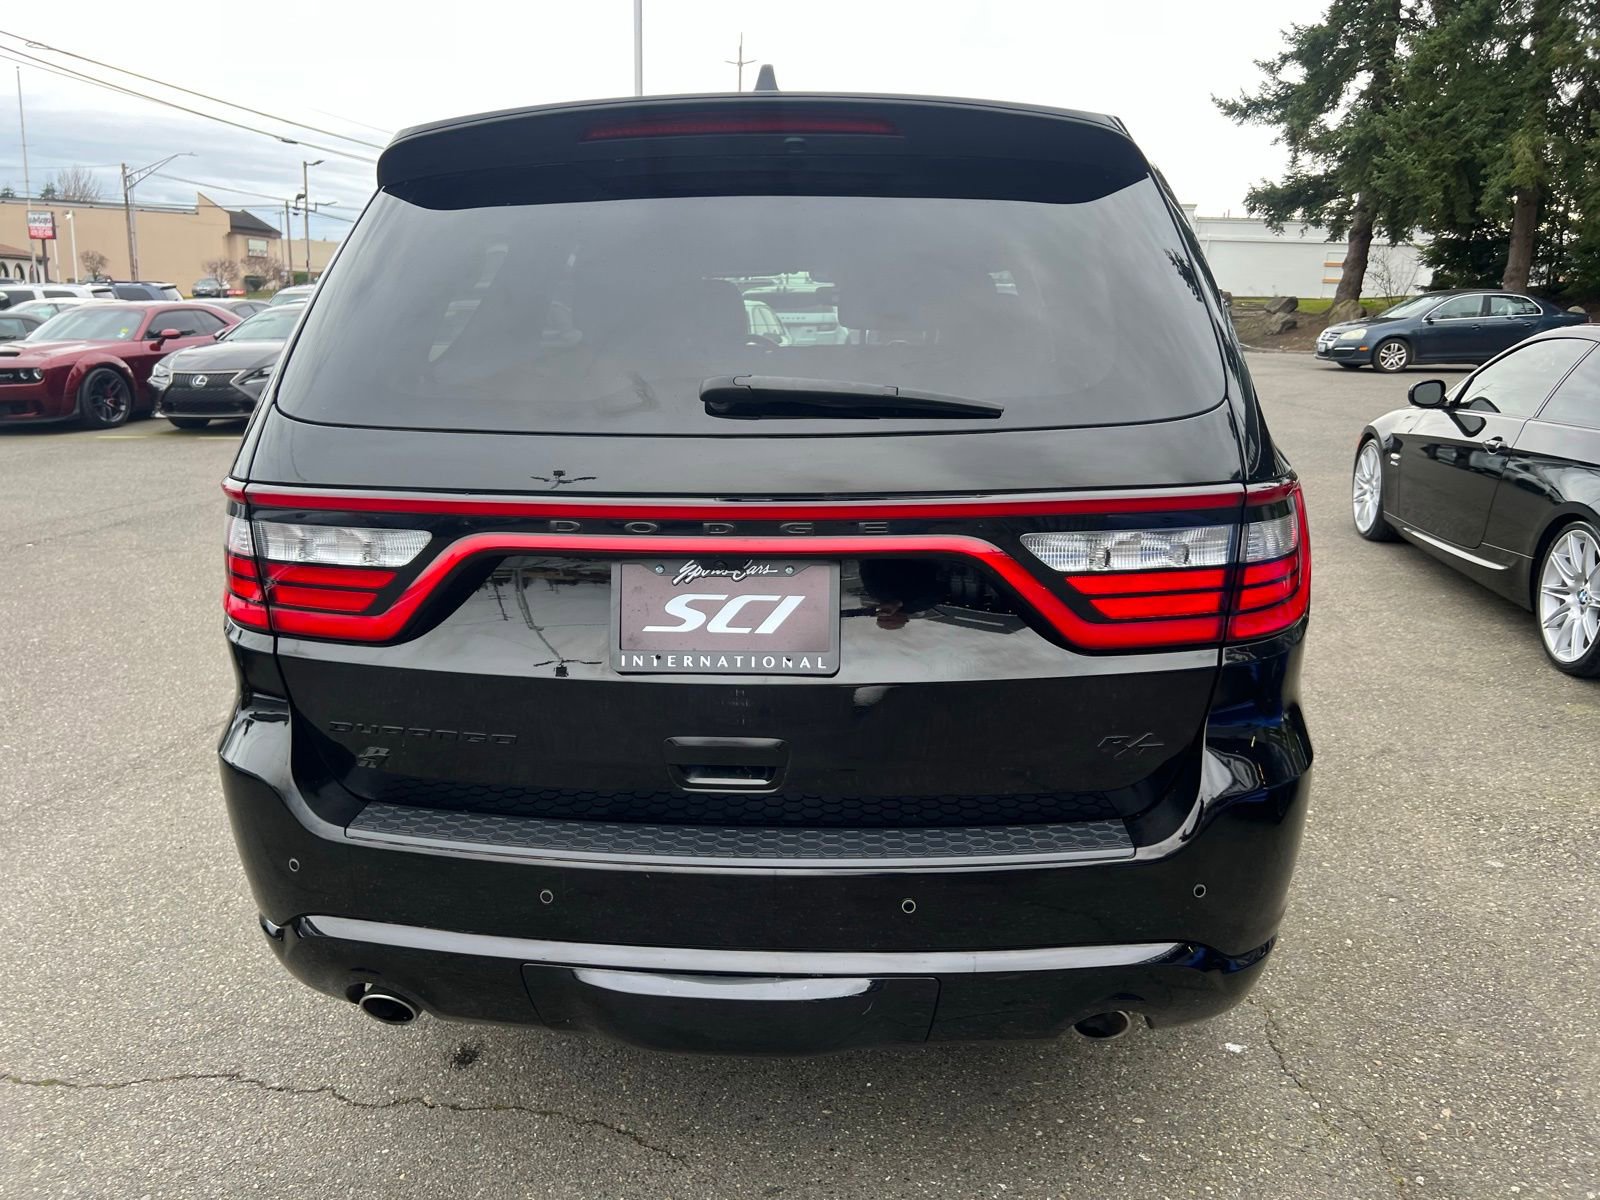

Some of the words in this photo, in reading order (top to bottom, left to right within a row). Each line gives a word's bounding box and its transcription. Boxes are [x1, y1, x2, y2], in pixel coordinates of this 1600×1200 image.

[549, 519, 890, 534] DODGE
[641, 593, 806, 634] SCI
[620, 654, 827, 669] INTERNATIONAL
